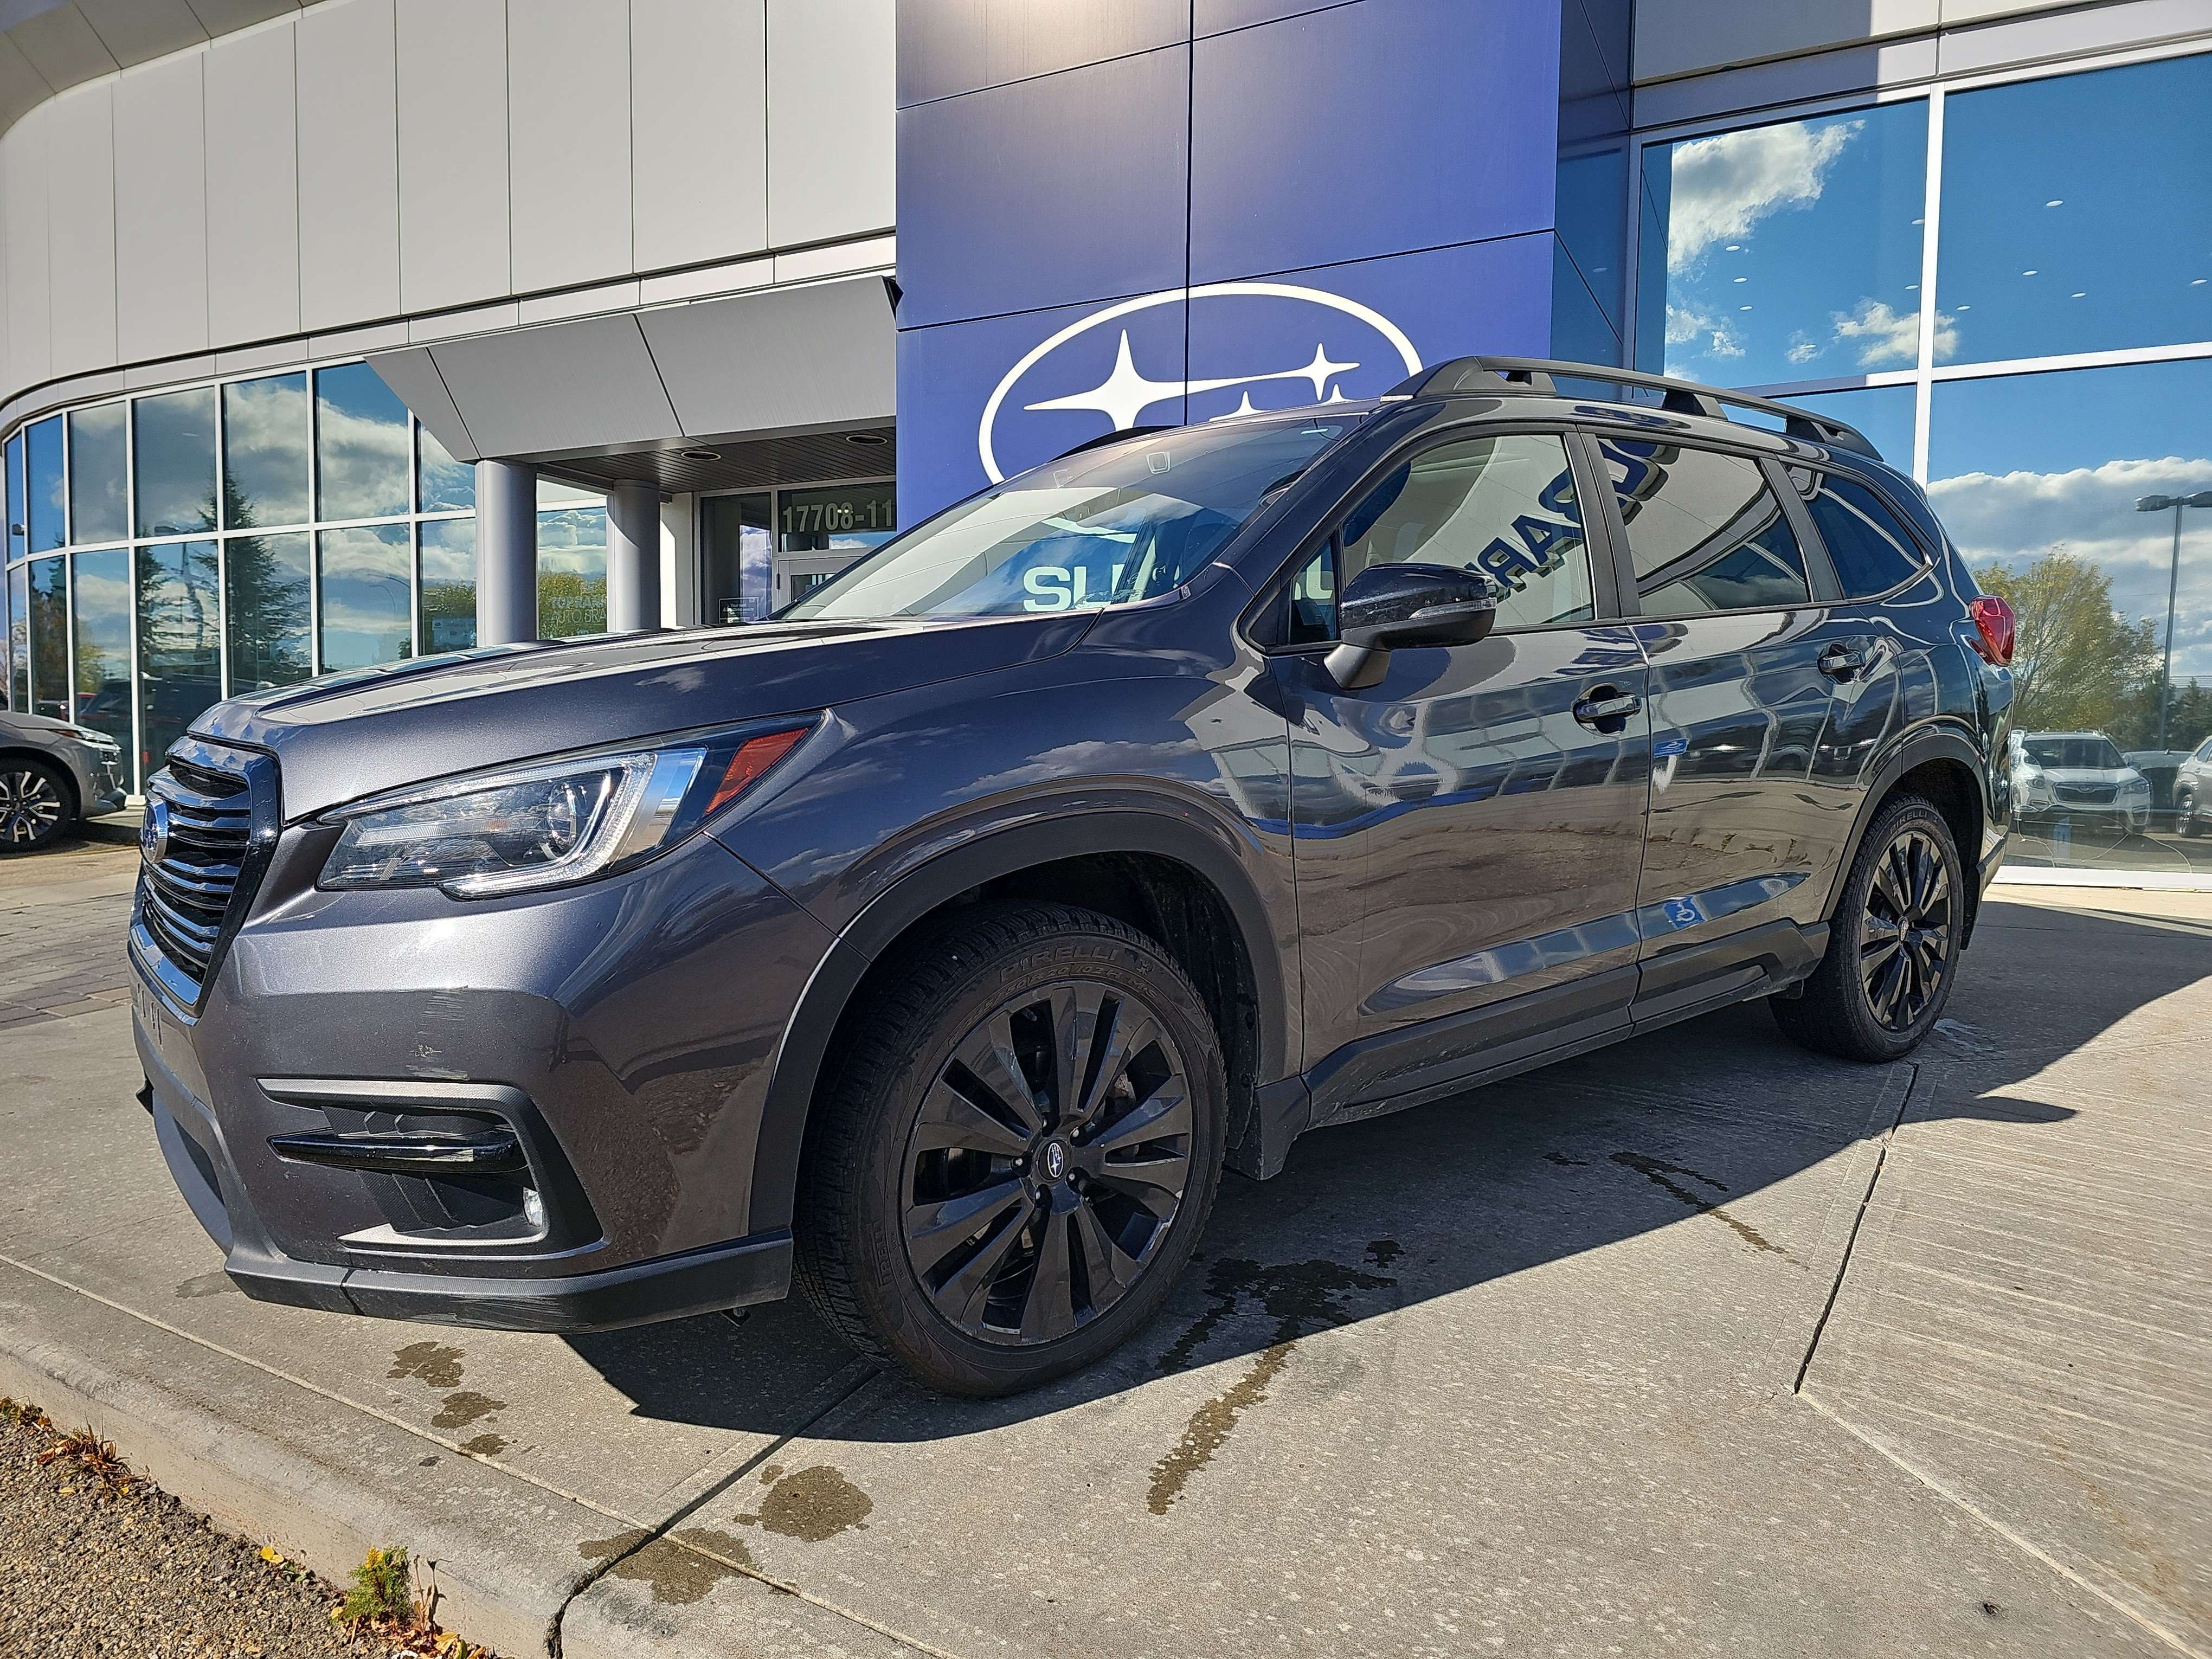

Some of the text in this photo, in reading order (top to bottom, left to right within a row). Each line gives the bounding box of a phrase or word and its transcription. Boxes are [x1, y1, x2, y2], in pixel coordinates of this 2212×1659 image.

[783, 499, 892, 533] 17708-11
[551, 609, 582, 623] AUTO
[1889, 810, 1927, 835] PIRELLI
[1001, 945, 1119, 983] PIRELLI
